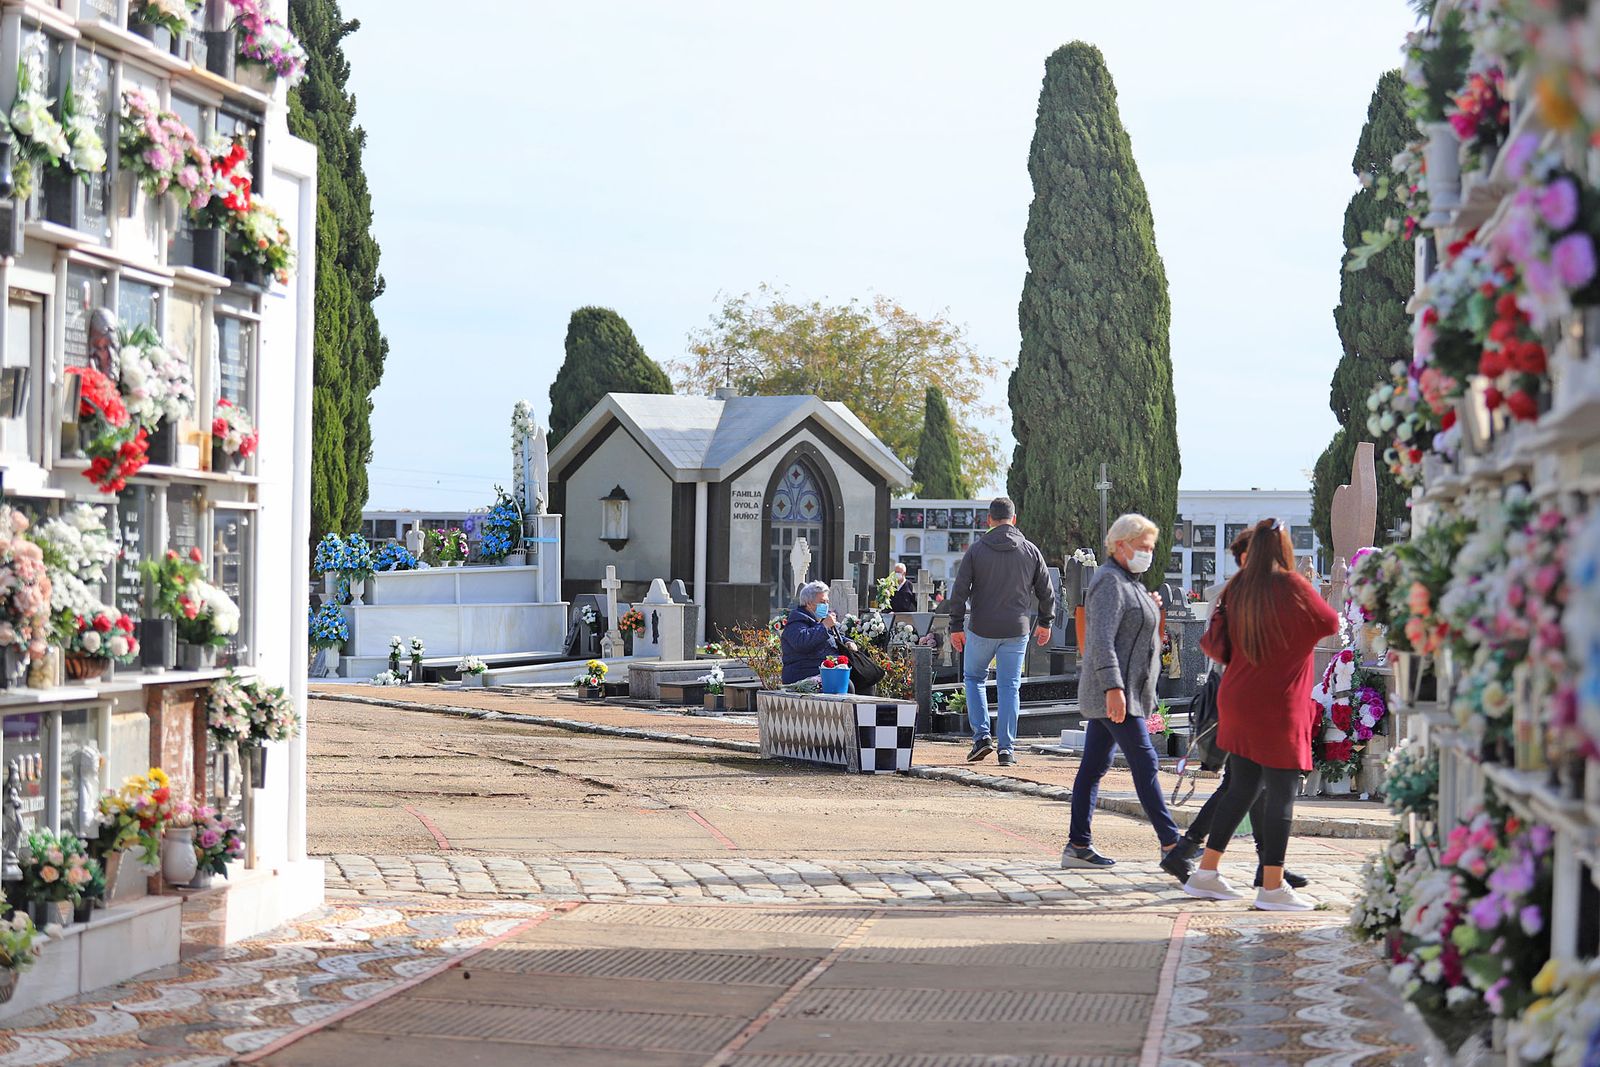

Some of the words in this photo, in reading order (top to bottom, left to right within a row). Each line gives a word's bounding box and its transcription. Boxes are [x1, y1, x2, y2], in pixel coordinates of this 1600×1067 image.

[732, 490, 762, 498] FAMILIA
[734, 501, 759, 509] OYOLA
[733, 511, 759, 520] MUÑOZ
